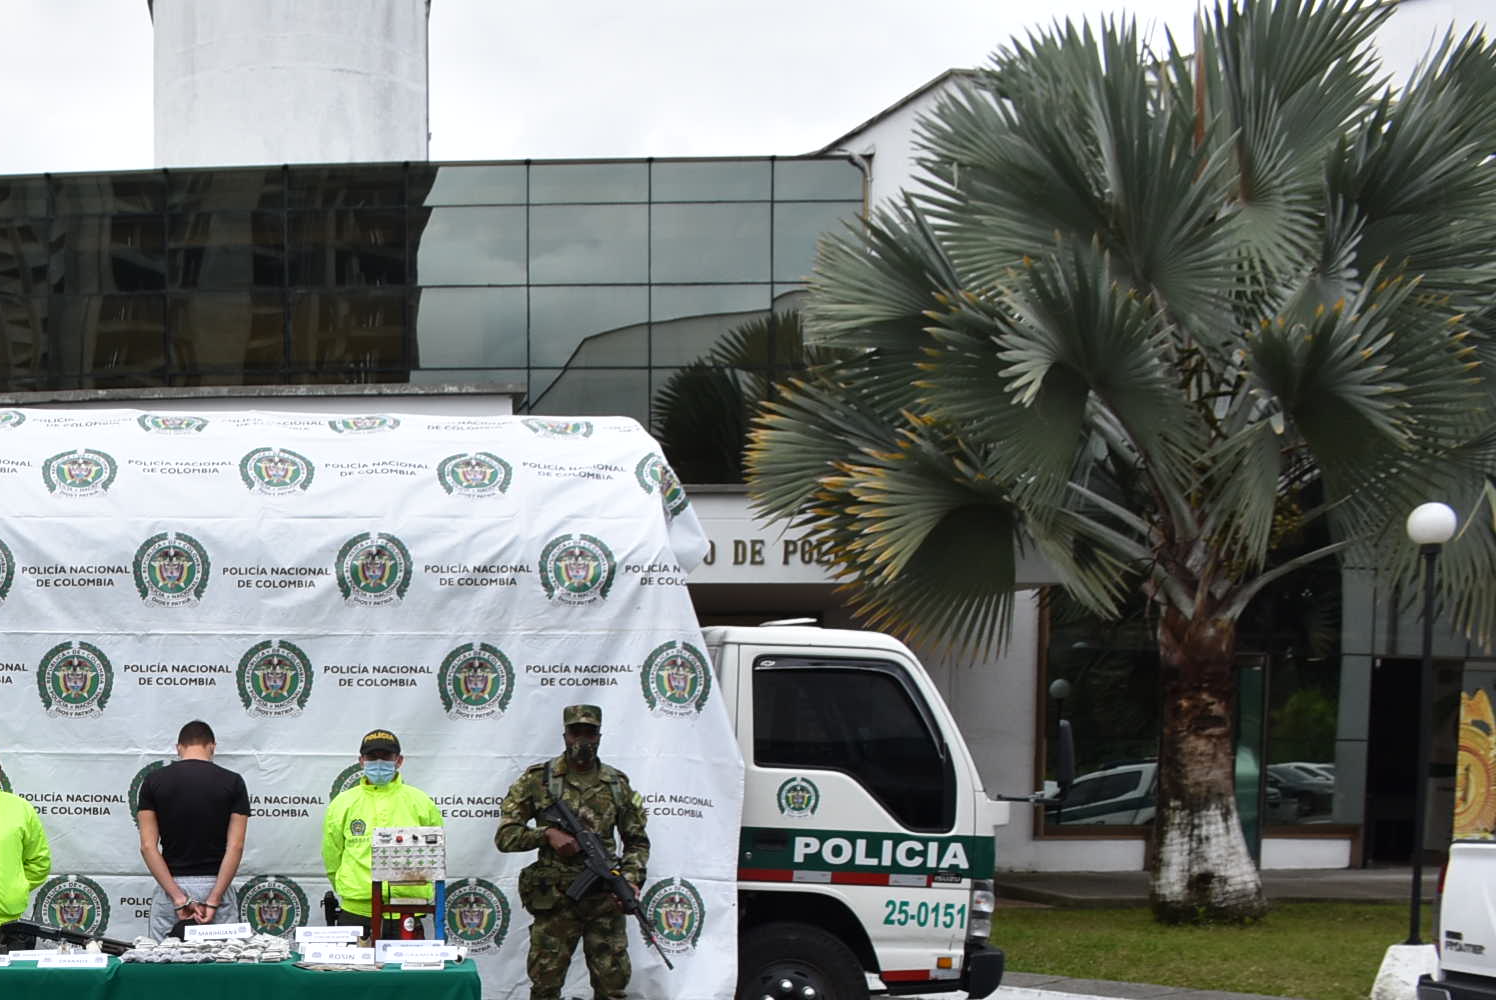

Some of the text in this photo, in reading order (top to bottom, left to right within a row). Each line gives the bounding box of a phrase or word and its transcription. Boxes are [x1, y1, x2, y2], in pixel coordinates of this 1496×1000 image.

[732, 539, 765, 566] DE
[22, 563, 130, 575] POLICÍA NACIONAL
[222, 564, 331, 576] POLICÍA NACIONAL
[424, 563, 533, 574] POLICÍA NACIONAL
[36, 577, 115, 588] DE COLOMBIA
[237, 579, 316, 589] DE COLOMBIA
[439, 577, 518, 586] DE COLOMBIA
[640, 576, 655, 586] DE
[123, 662, 232, 674] POLICÍA NACIONAL
[323, 663, 433, 674] POLICÍA NACIONAL
[525, 662, 633, 674] POLICÍA NACIONAL
[138, 677, 217, 687] DE COLOMBIA
[338, 678, 418, 687] DE COLOMBIA
[540, 677, 618, 687] DE COLOMBIA
[66, 794, 126, 804] NACIONAL
[263, 796, 324, 805] NACIONAL
[432, 795, 504, 805] LICÍA NACIO
[643, 792, 666, 803] ICÍA
[50, 806, 111, 816] COLOMBIA
[451, 809, 502, 818] COLOMB
[793, 836, 970, 869] POLICIA
[120, 897, 153, 906] POLIC
[135, 910, 150, 918] DE
[882, 899, 967, 929] 25-0151
